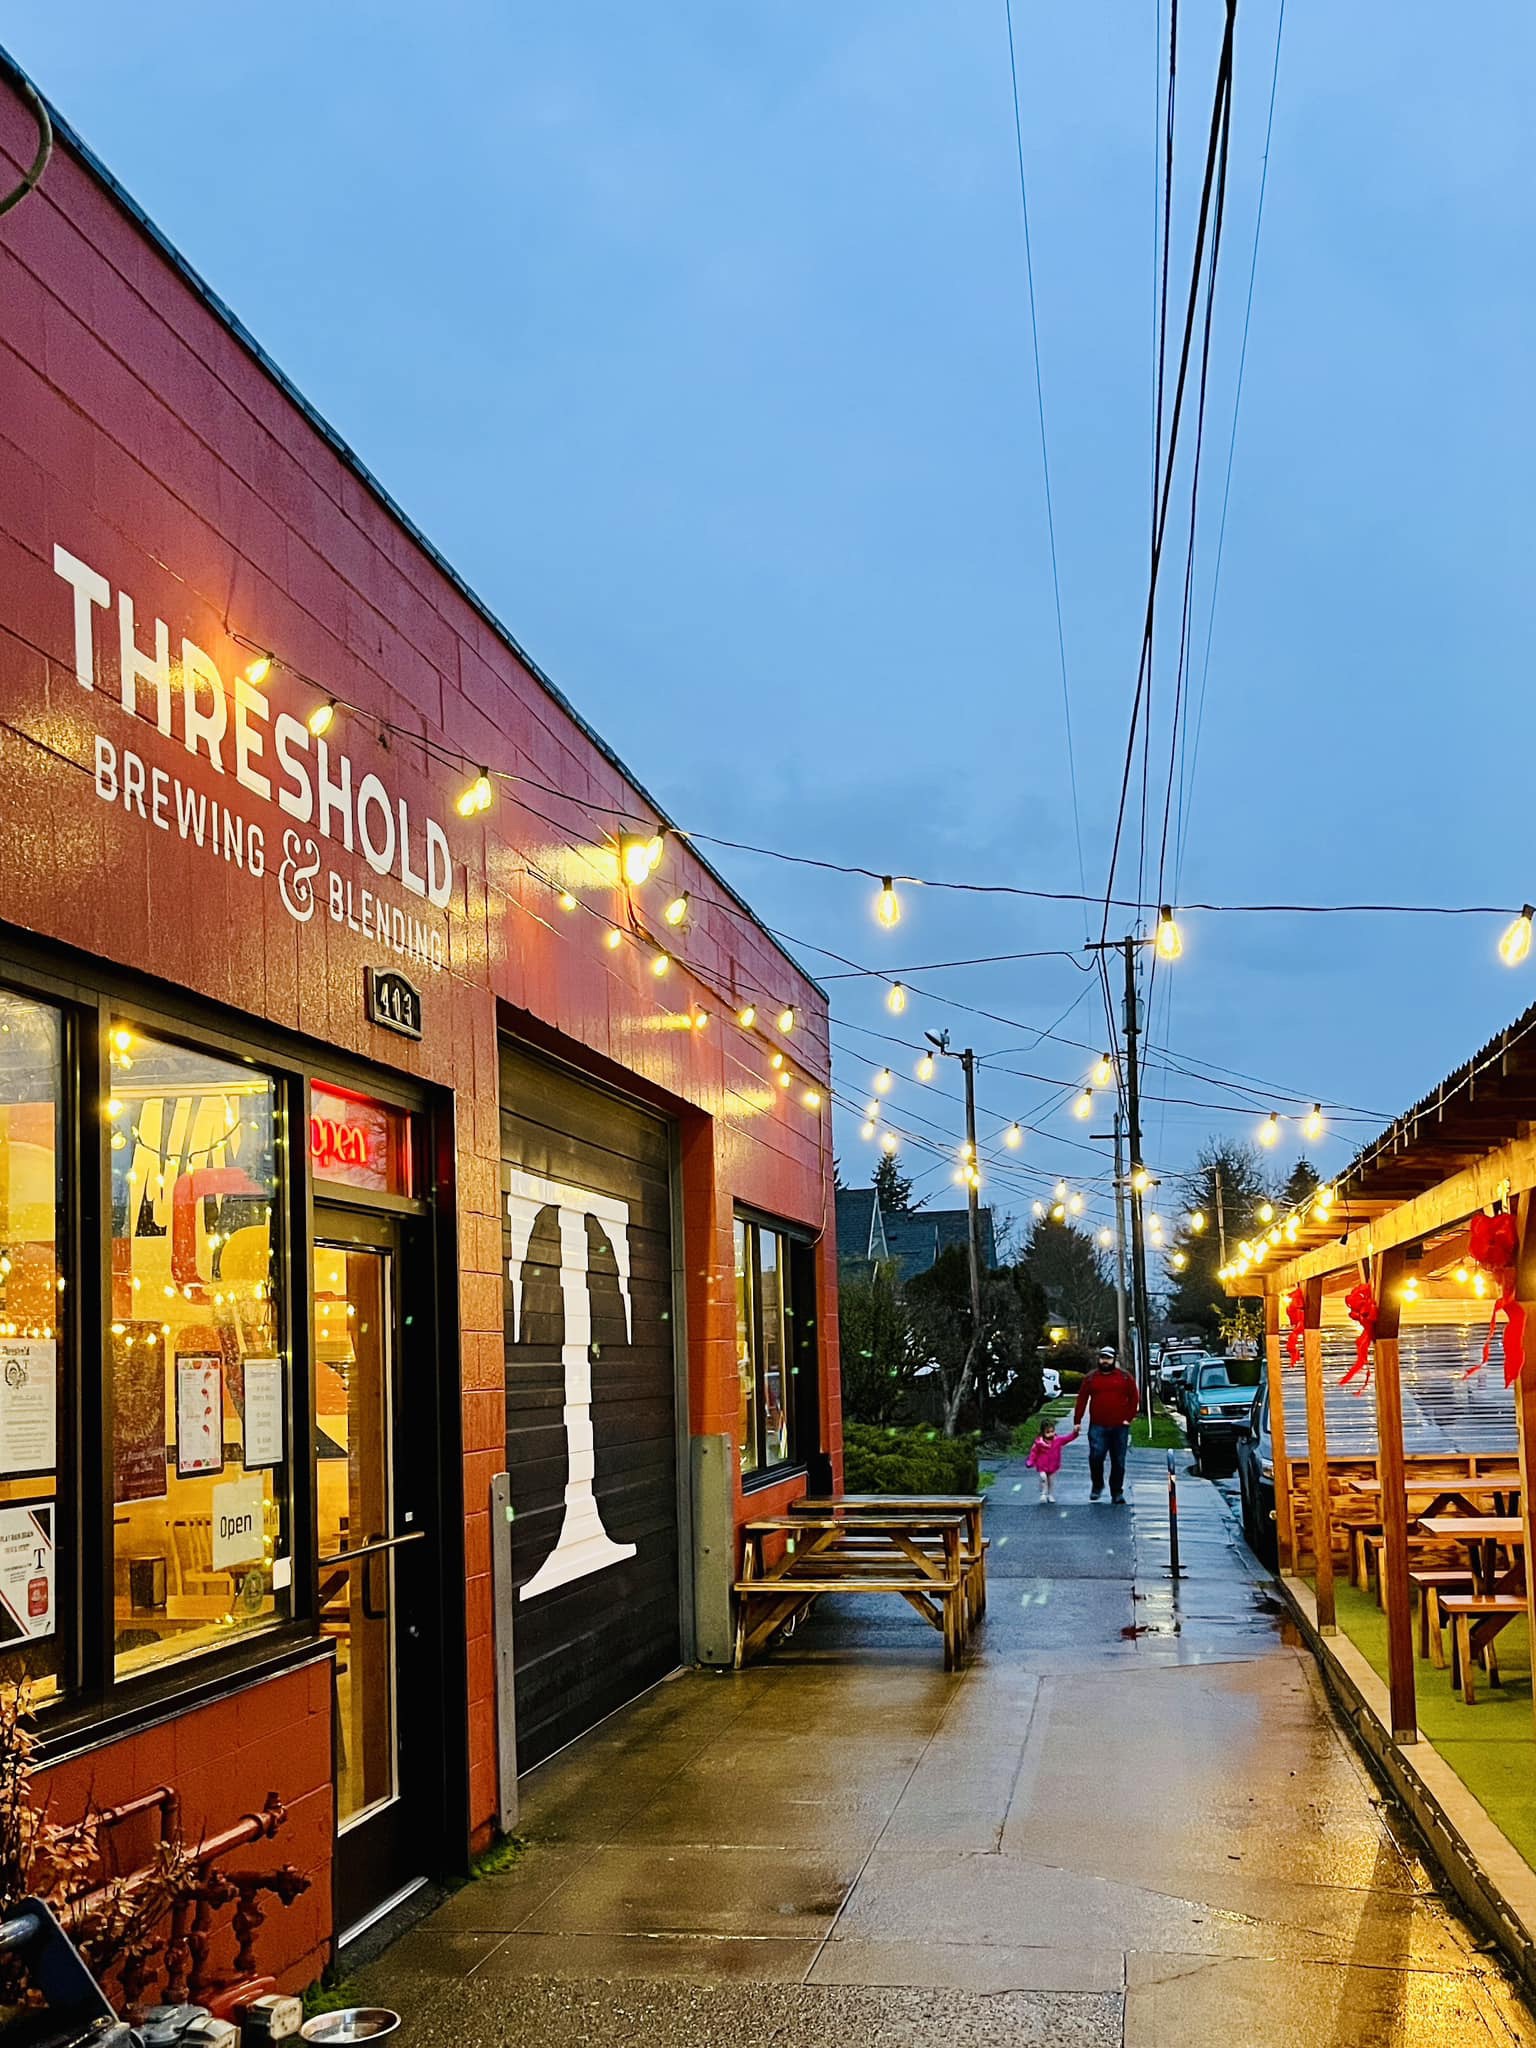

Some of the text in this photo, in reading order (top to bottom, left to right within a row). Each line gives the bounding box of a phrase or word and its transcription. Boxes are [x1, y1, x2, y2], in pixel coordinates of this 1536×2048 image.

[54, 543, 453, 909] THRESHOLD
[94, 735, 443, 972] BREWING & BLENDING
[381, 983, 413, 1026] 403
[220, 1514, 252, 1540] Open
